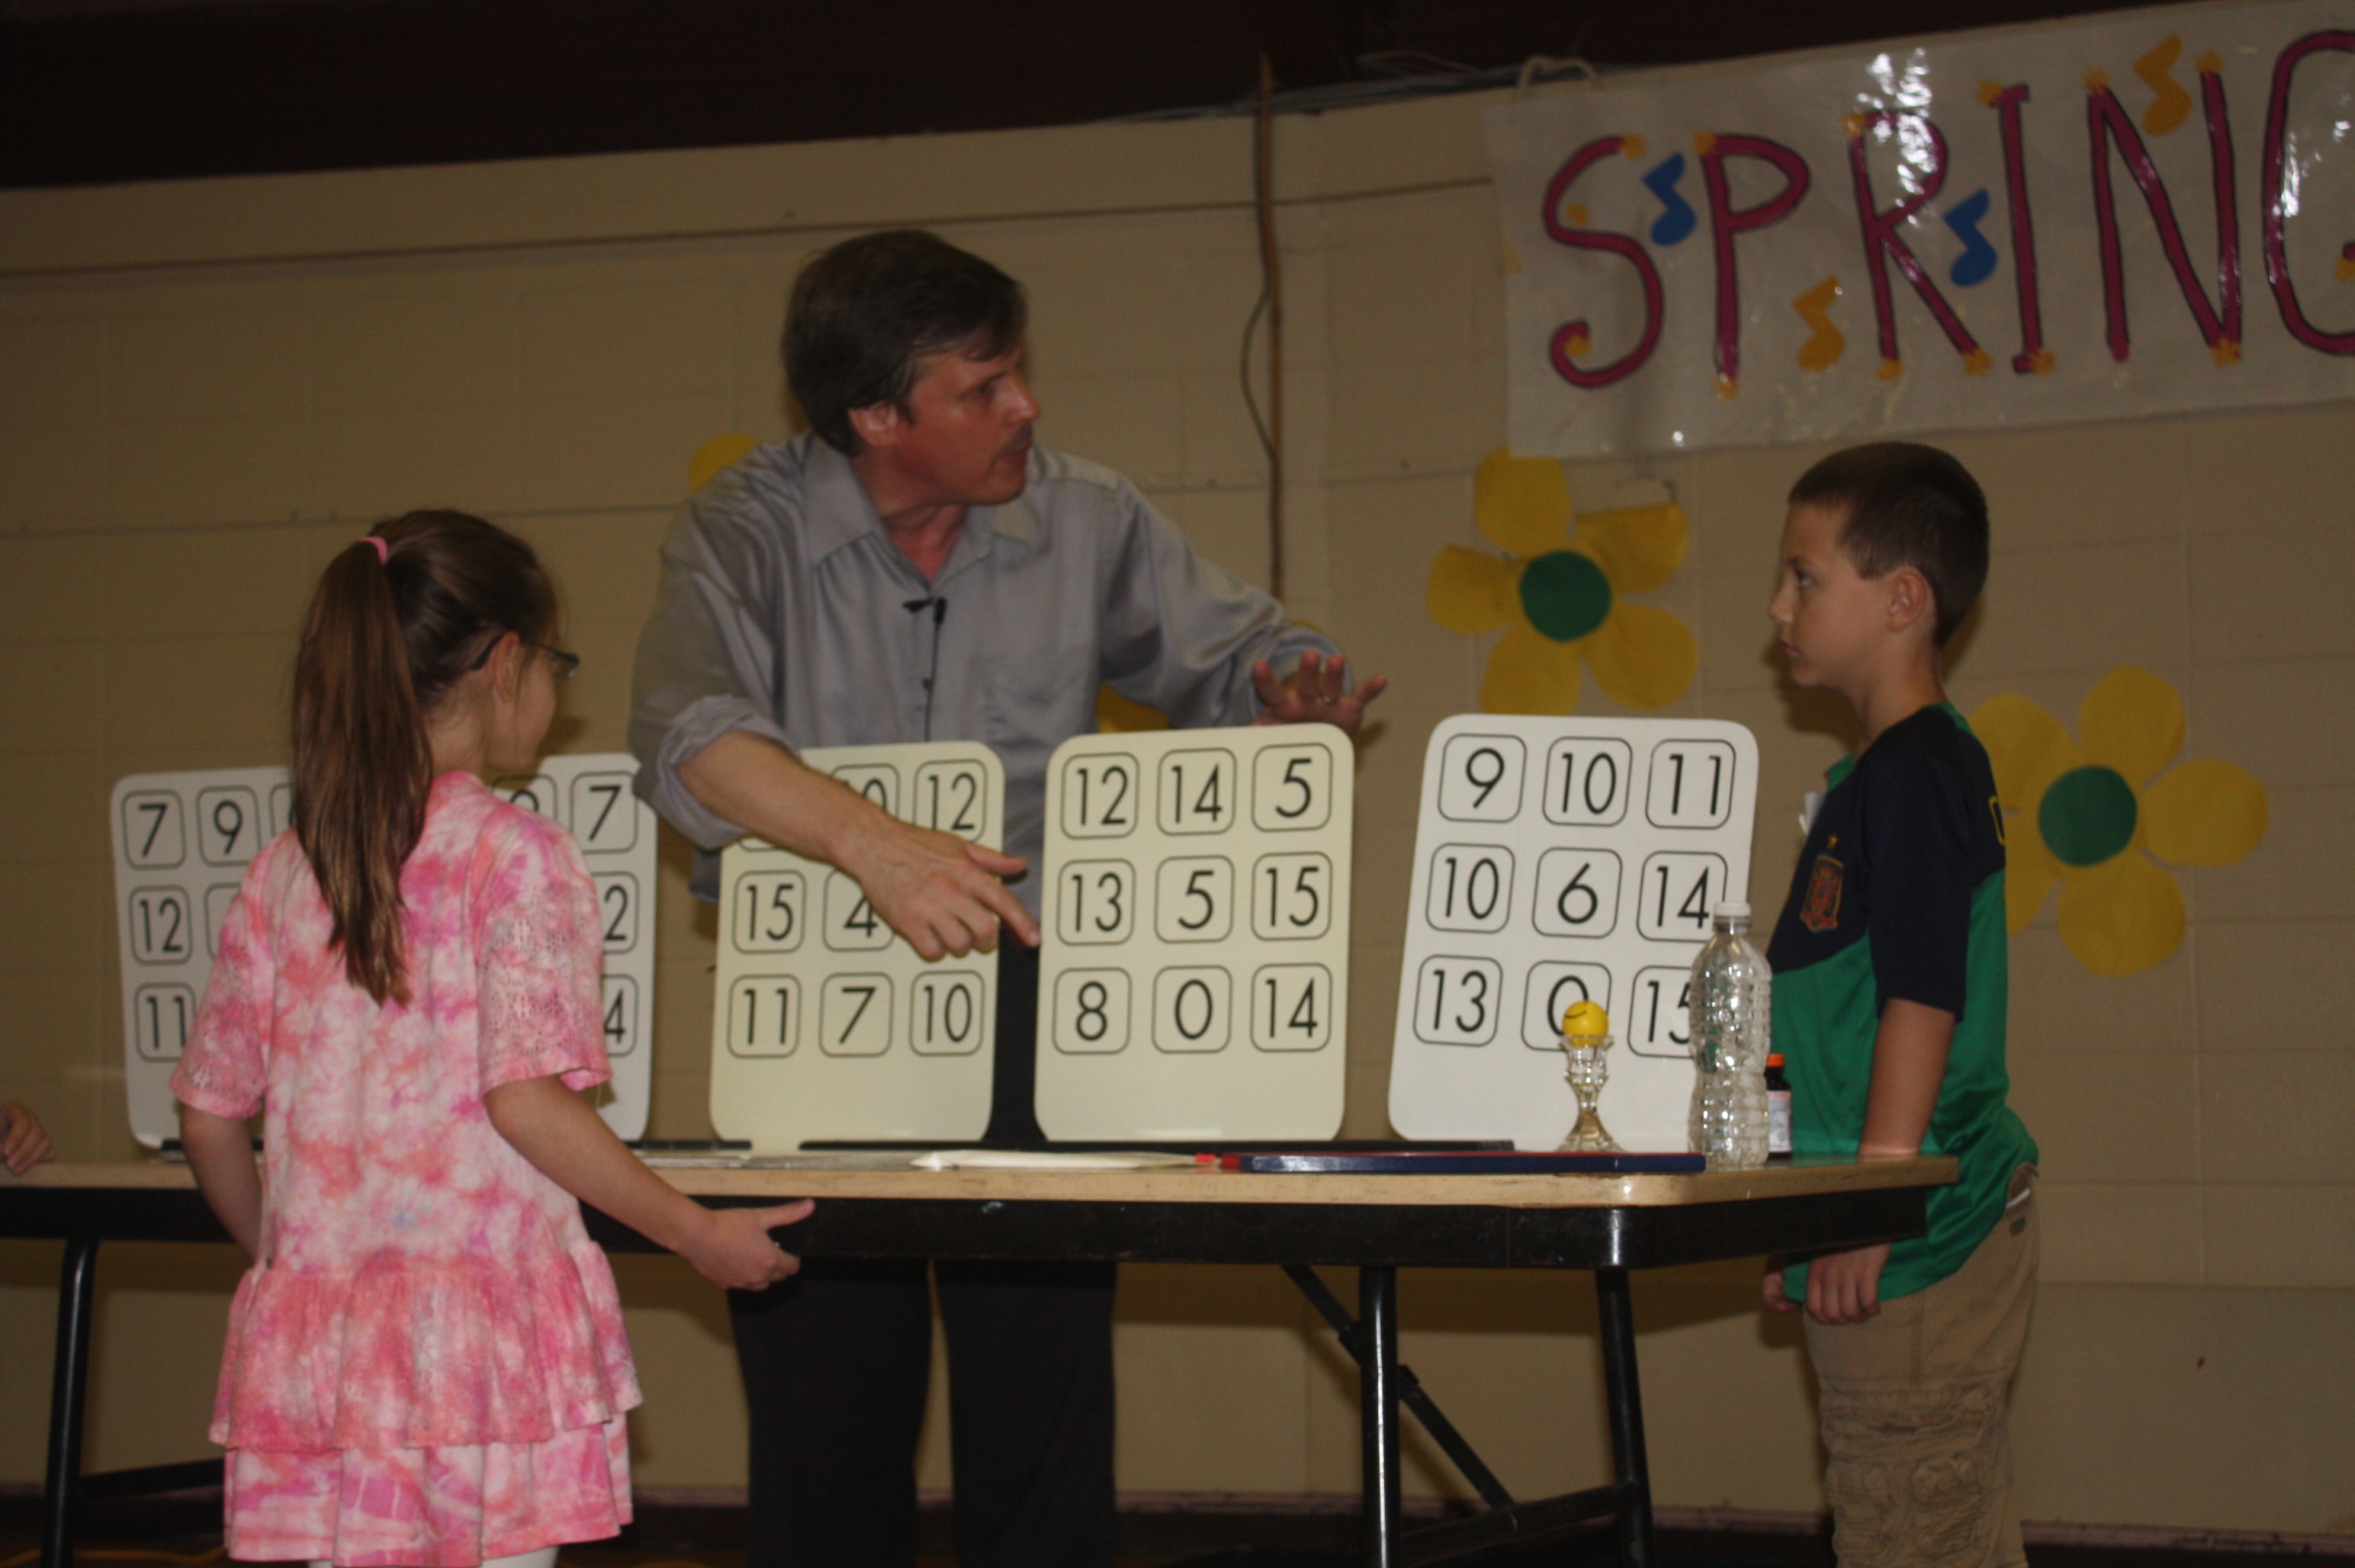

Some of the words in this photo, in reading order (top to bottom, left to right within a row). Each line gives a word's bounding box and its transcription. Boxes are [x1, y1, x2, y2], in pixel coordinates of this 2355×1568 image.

[927, 772, 977, 831] 12
[1077, 766, 1128, 825] 12
[1171, 765, 1222, 823] 14
[1276, 757, 1312, 818] 5
[1466, 747, 1505, 808] 9
[1562, 752, 1617, 815] 10
[1669, 753, 1724, 817] 11
[139, 802, 169, 857] 7
[213, 799, 243, 854] 9
[589, 784, 622, 841] 7
[603, 884, 628, 942] 2
[747, 883, 794, 941] 15
[843, 895, 879, 938] 4
[1071, 872, 1122, 933] 13
[1178, 869, 1214, 930] 5
[1267, 866, 1319, 927] 15
[1445, 857, 1499, 920] 10
[1557, 863, 1598, 924] 6
[1657, 866, 1710, 929] 14
[139, 897, 183, 953] 12
[146, 995, 185, 1049] 11
[602, 988, 626, 1043] 4
[744, 988, 789, 1045] 11
[839, 986, 876, 1044] 7
[924, 983, 972, 1043] 10
[1075, 981, 1108, 1042] 8
[1174, 978, 1213, 1040] 0
[1266, 978, 1318, 1038] 14
[1433, 969, 1487, 1033] 13
